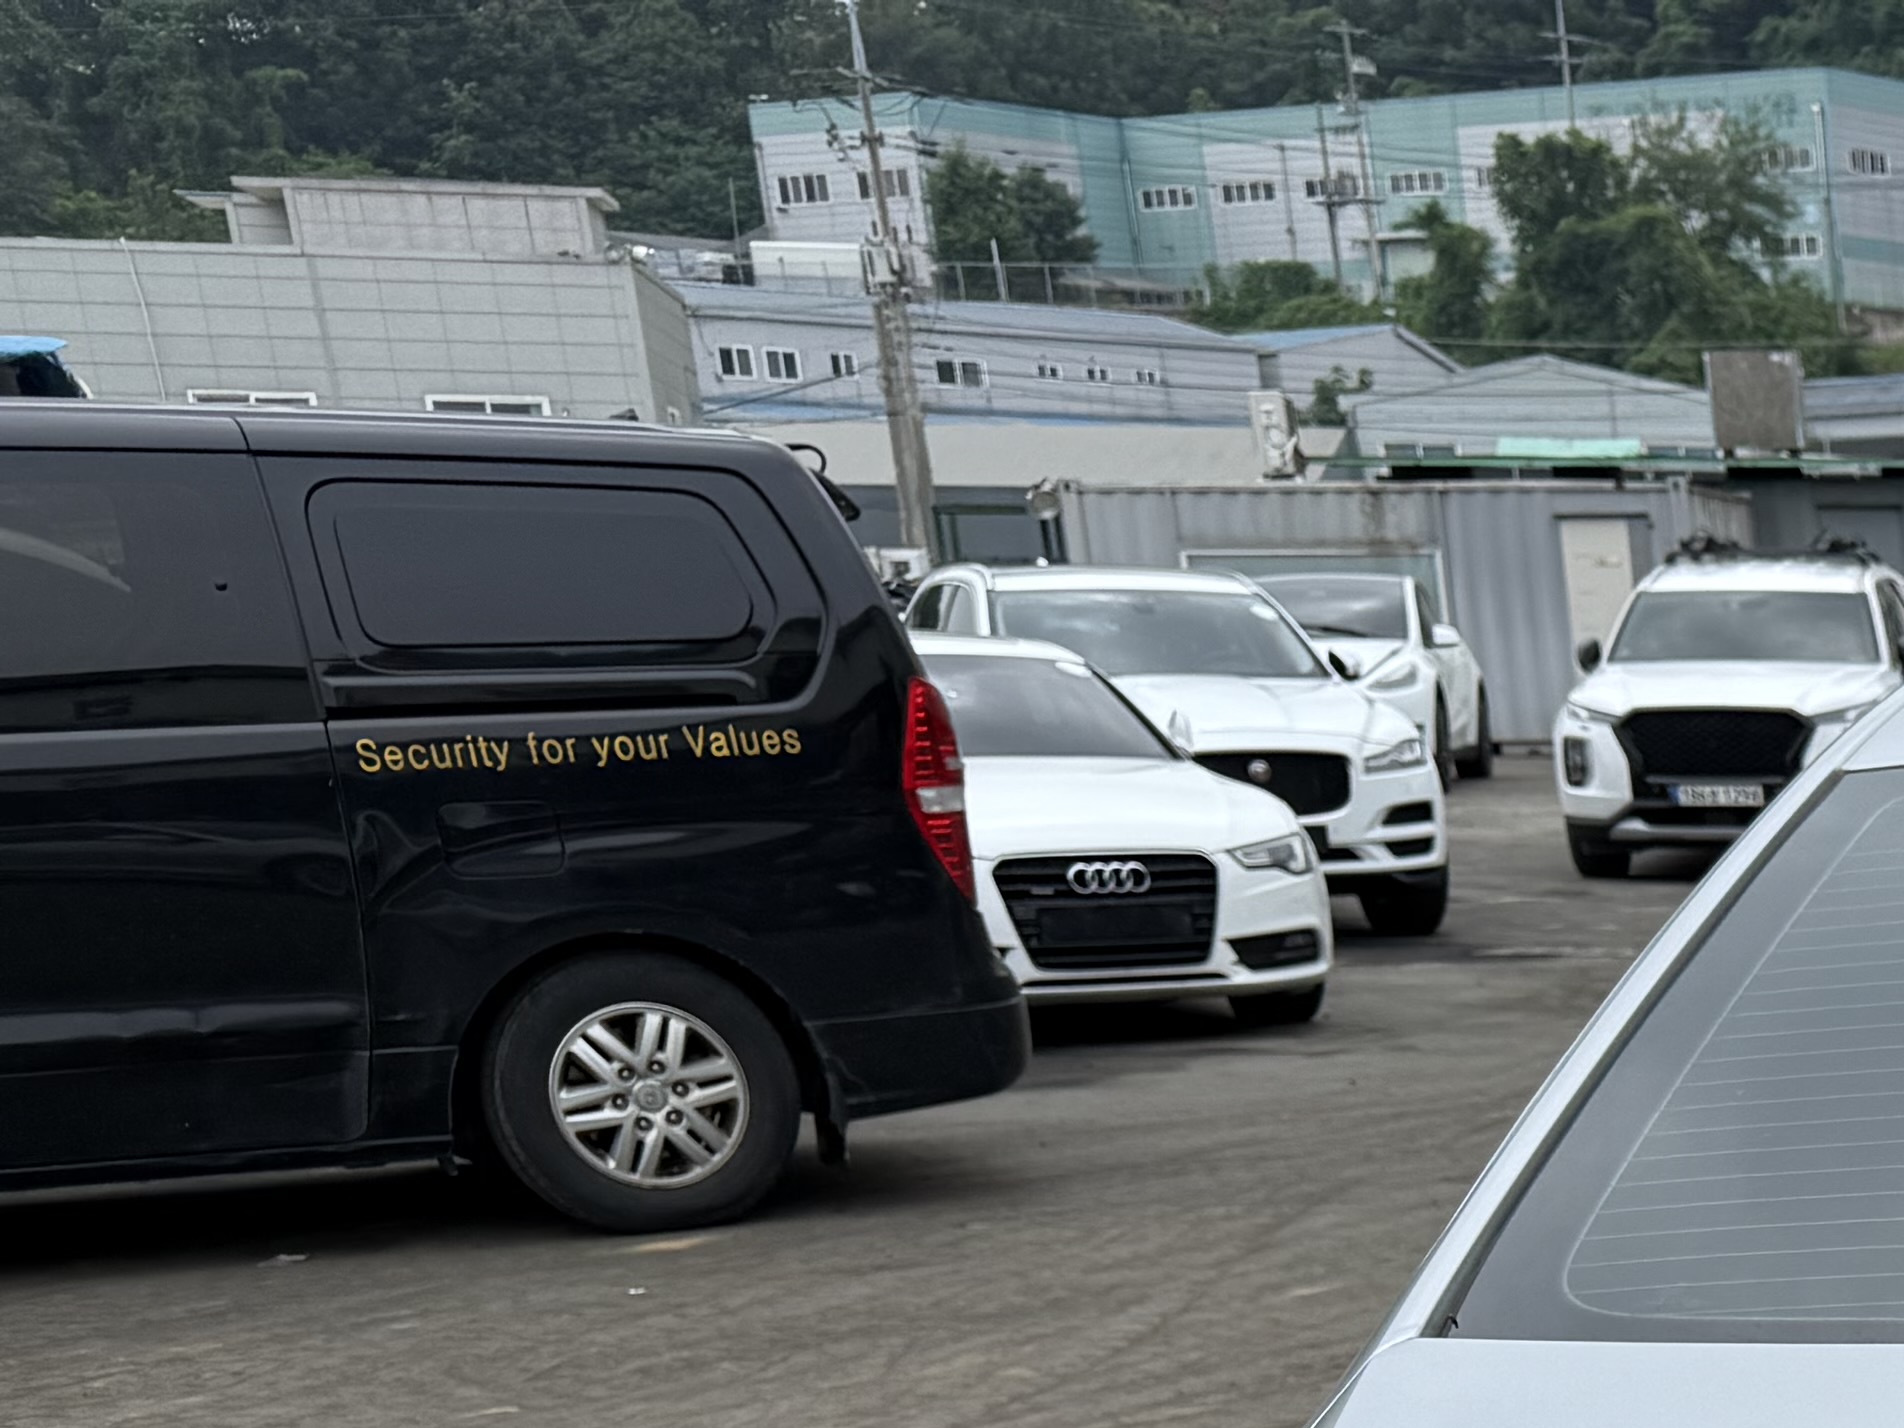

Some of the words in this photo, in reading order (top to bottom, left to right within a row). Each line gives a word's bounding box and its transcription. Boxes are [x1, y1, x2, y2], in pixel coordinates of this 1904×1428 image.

[355, 734, 509, 772] Security
[526, 732, 576, 766] for
[592, 732, 669, 767] your
[681, 724, 802, 759] Values
